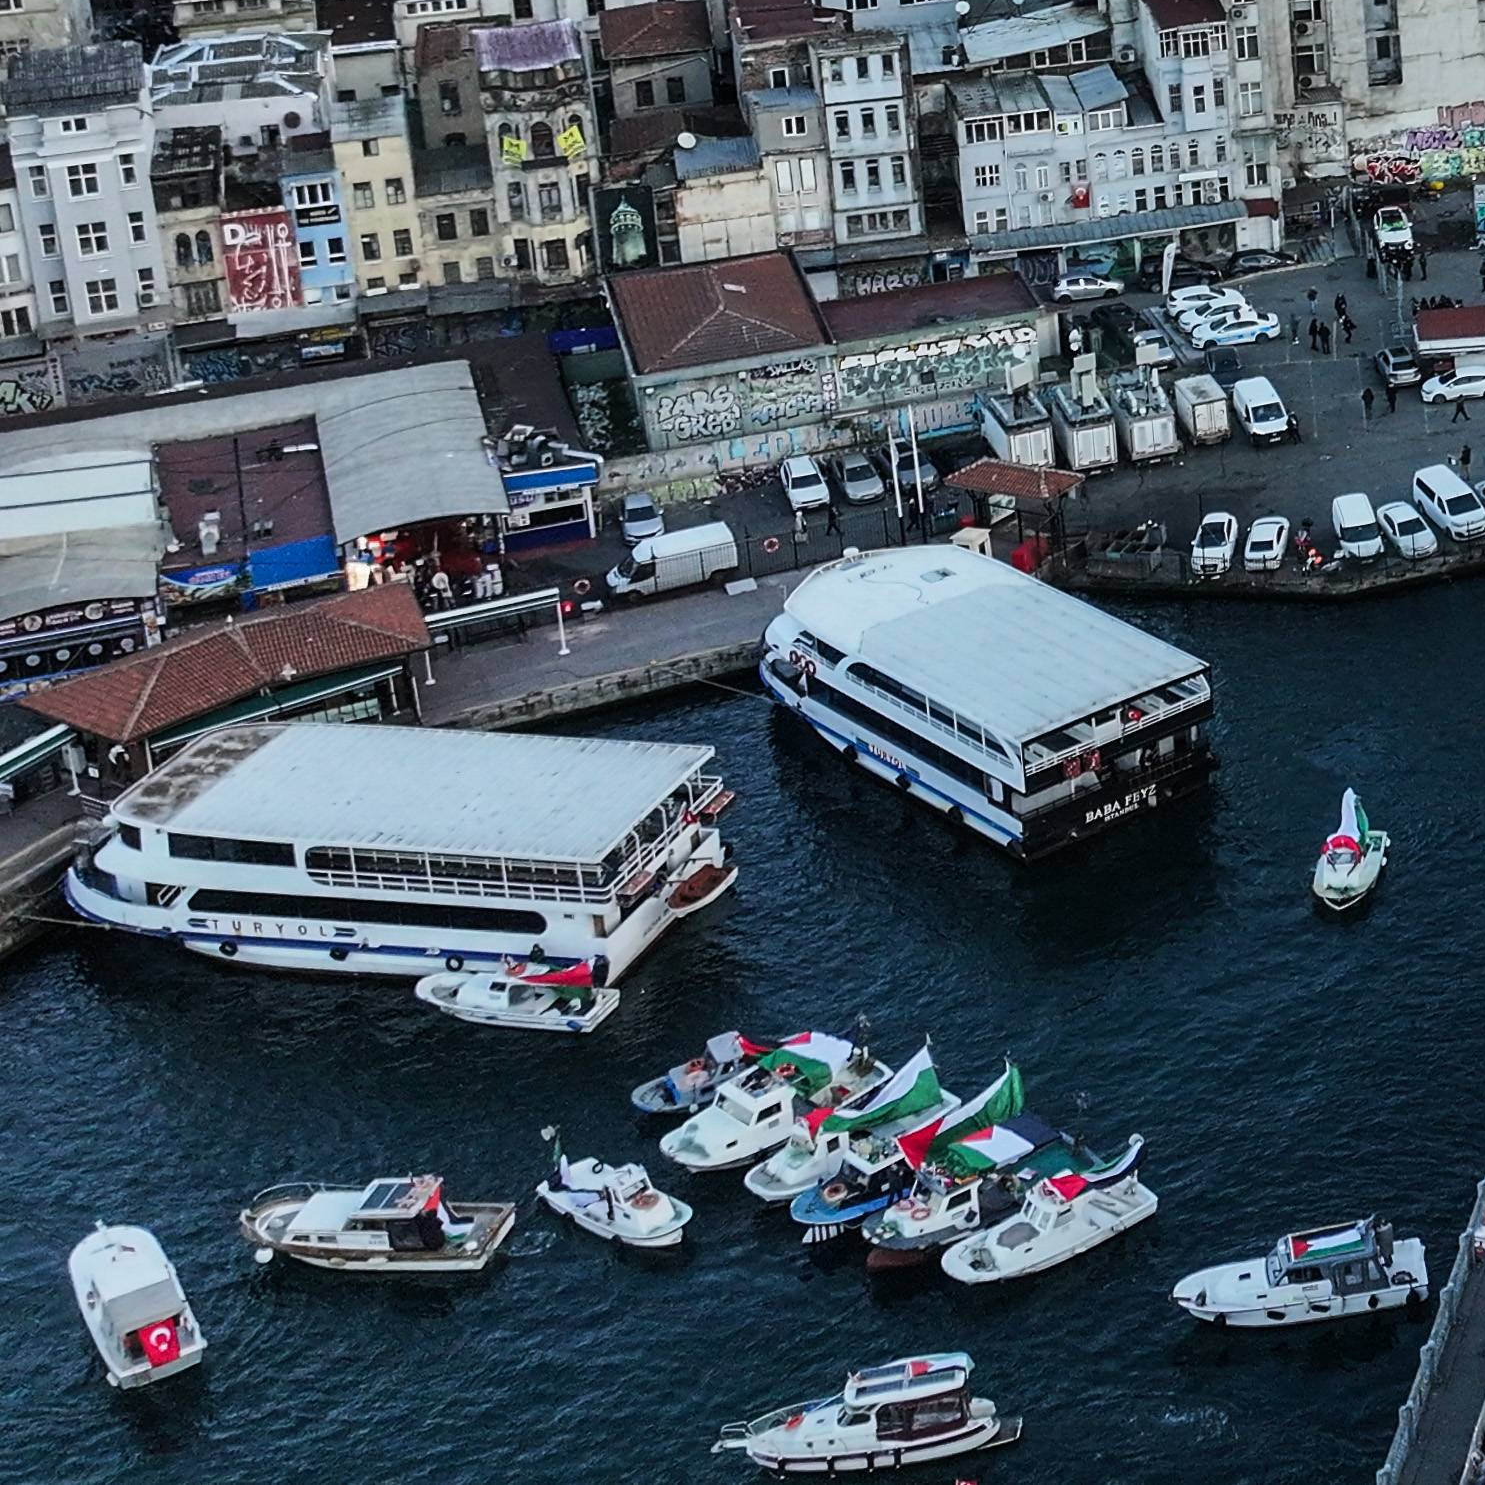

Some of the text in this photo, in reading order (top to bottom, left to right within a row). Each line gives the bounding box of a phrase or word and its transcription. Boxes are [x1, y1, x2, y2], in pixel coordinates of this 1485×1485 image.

[1085, 784, 1157, 824] BABA FEYZ
[210, 918, 327, 937] TURYOL
